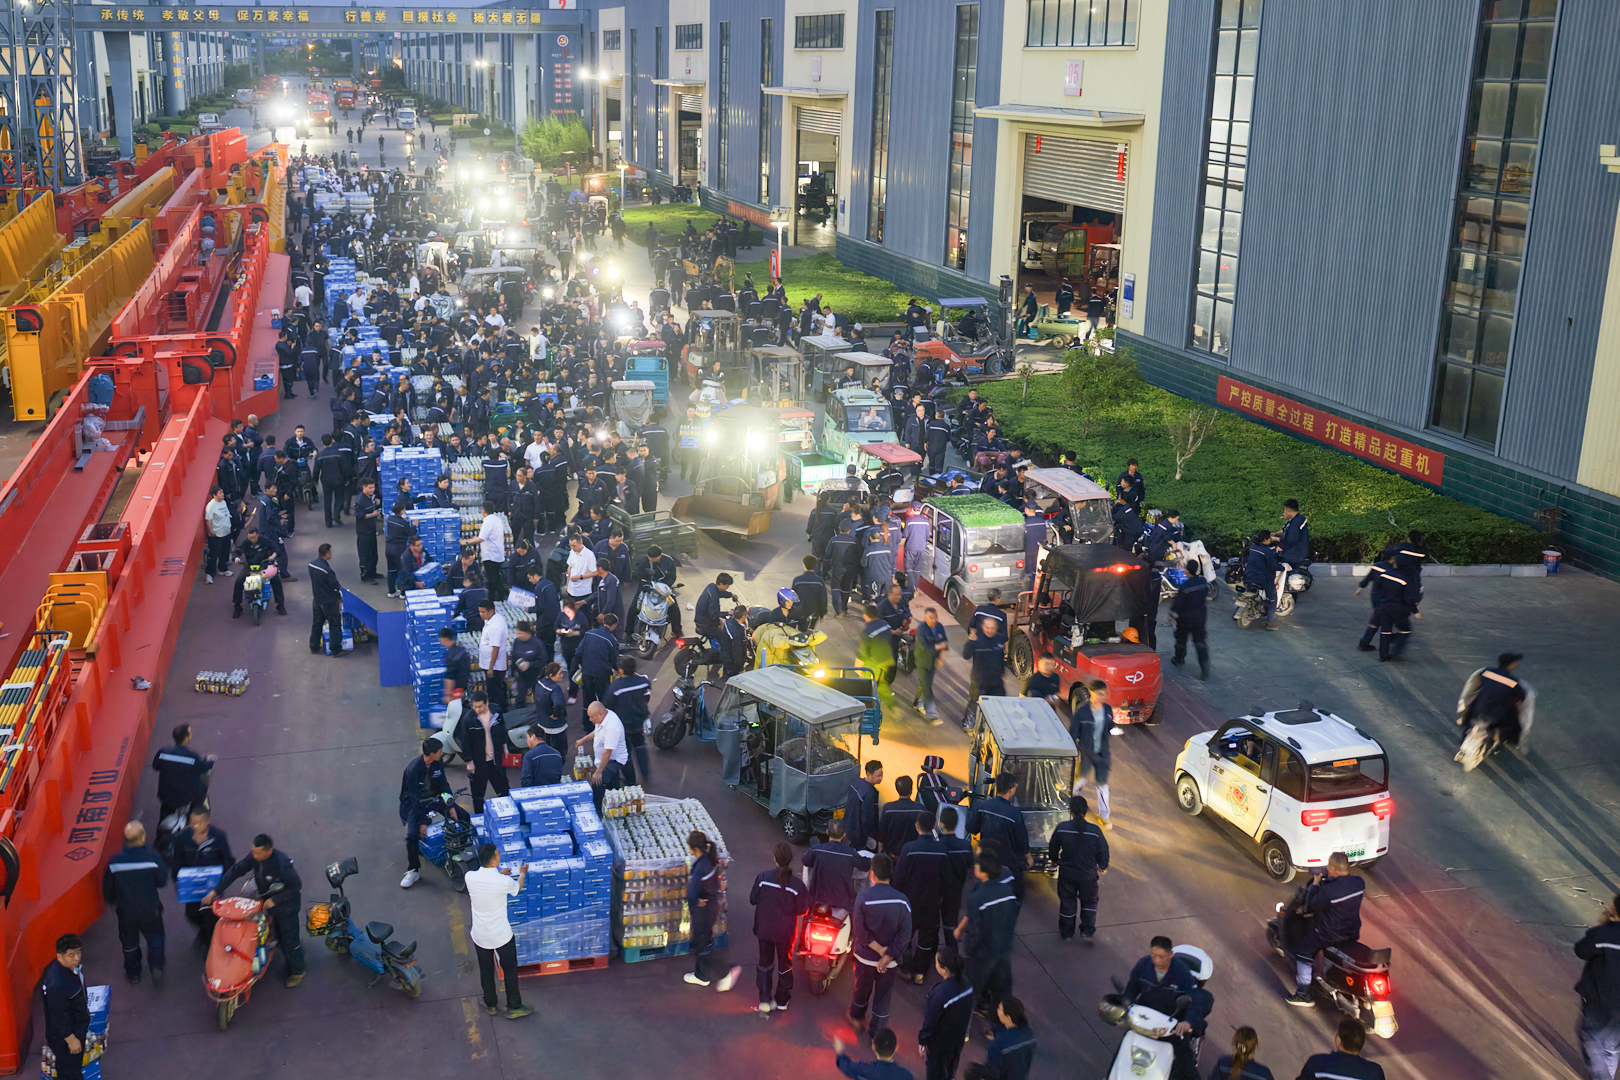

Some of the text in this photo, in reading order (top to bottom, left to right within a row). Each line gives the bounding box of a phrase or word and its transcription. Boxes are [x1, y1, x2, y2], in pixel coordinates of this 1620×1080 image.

[100, 8, 541, 24] 承传统 孝敬父母 促万家幸福 行善举 回报社会 扬大爱无疆
[1067, 63, 1080, 85] 05
[1228, 385, 1430, 476] 严控质量全过程 打造精品起重机
[67, 769, 120, 844] 河南矿山
